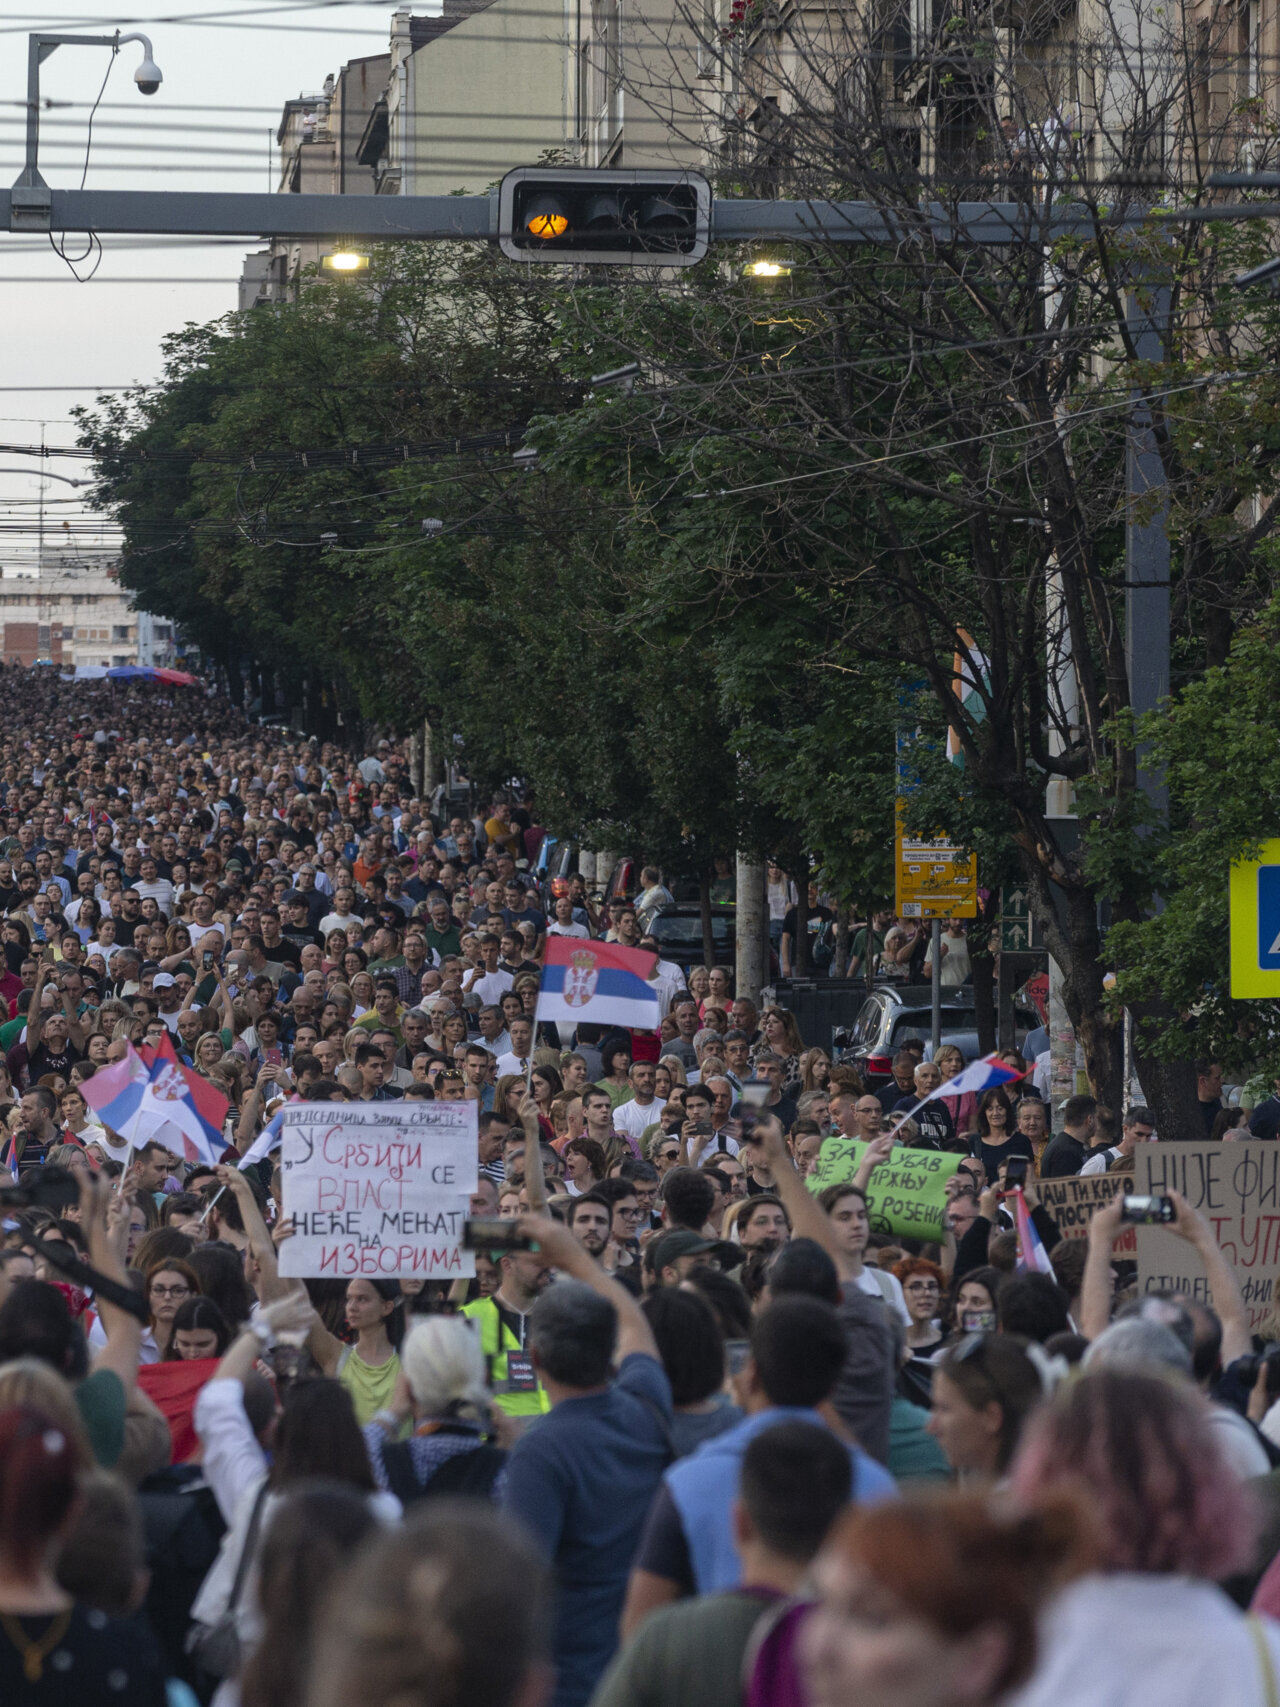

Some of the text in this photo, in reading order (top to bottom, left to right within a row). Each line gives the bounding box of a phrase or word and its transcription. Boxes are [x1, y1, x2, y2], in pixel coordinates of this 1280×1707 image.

[824, 1143, 856, 1162] ЗА
[431, 1165, 456, 1185] СЕ
[815, 1164, 835, 1182] НЕ
[1233, 1149, 1280, 1214] ФИ
[318, 1176, 413, 1212] ВЛАСТ
[1091, 1177, 1134, 1200] КАКО
[358, 1233, 383, 1249] НА
[319, 1243, 462, 1274] ИЗБОРИМА
